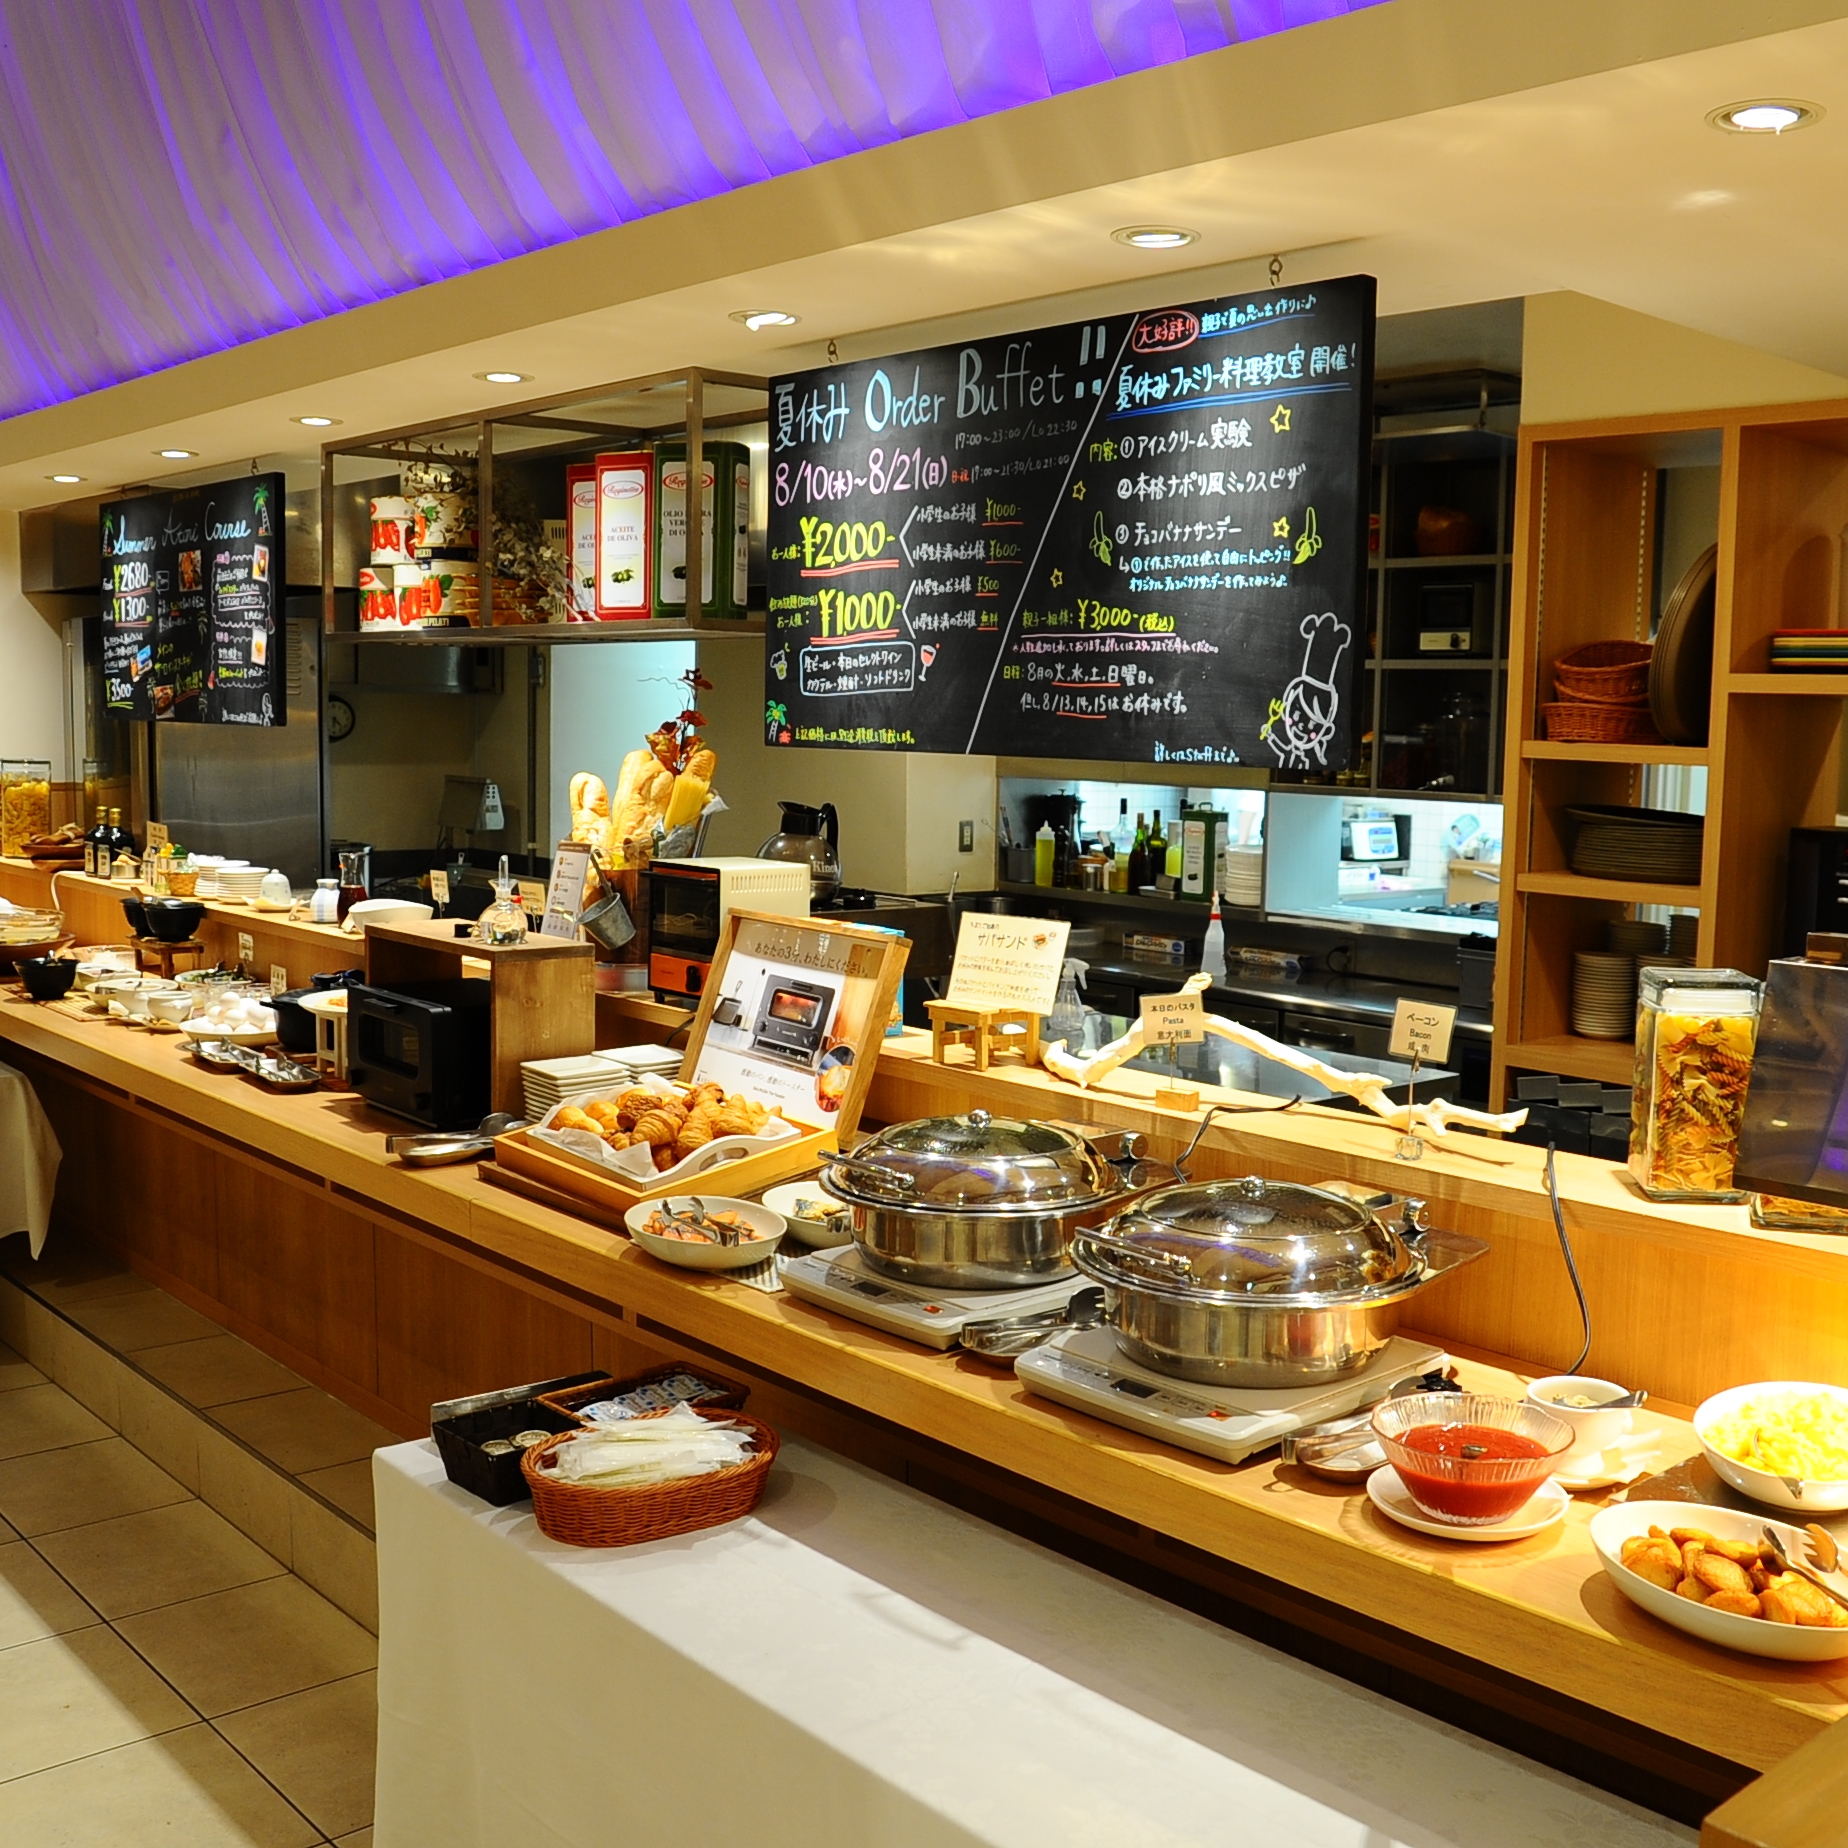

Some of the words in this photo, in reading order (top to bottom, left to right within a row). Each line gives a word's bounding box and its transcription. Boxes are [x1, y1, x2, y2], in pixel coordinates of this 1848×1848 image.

[1137, 317, 1193, 347] 大好評!!
[1116, 343, 1305, 411] 夏休みファミリー料理教室
[774, 382, 849, 452] 夏休み
[865, 366, 945, 432] Order
[955, 341, 1065, 418] Buffet
[113, 514, 157, 555] Summer
[204, 501, 251, 541] Course
[980, 610, 998, 627] 無料
[977, 932, 1028, 950] サバサンド
[1151, 1002, 1195, 1012] 本日のパスタ
[1163, 1016, 1184, 1025] Pasta
[1406, 1012, 1440, 1027] ベーコン
[1409, 1028, 1432, 1040] Bacon
